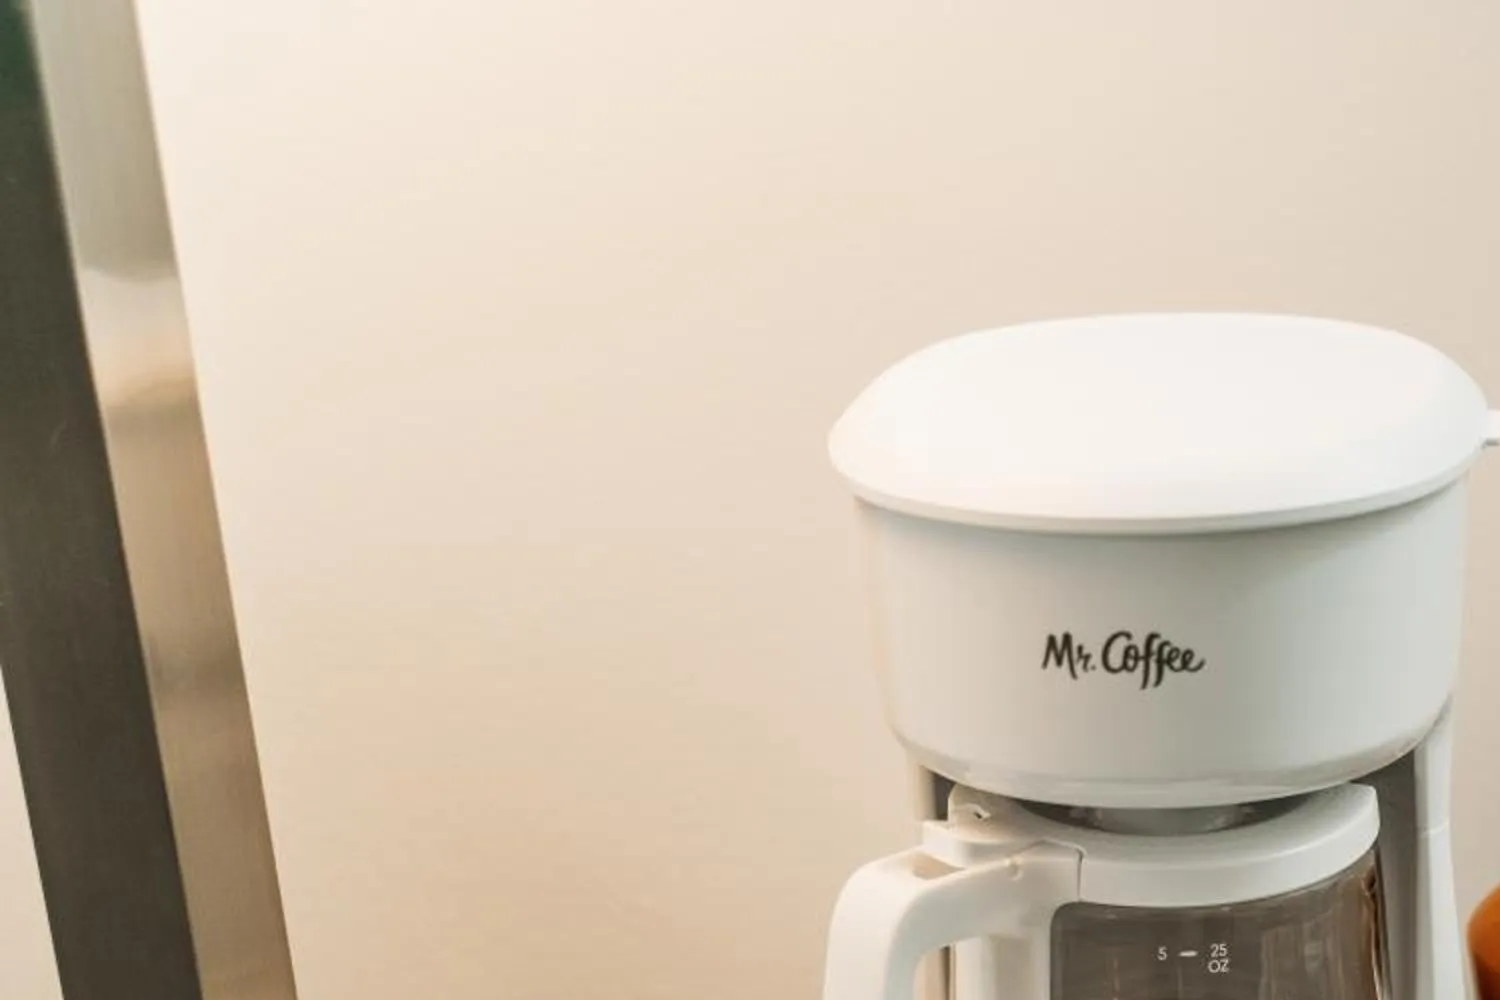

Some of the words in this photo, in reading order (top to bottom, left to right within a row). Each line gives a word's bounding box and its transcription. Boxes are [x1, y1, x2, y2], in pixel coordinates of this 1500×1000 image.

[1042, 631, 1096, 680] Mr.
[1101, 630, 1206, 690] Coffee
[1157, 945, 1168, 961] 5
[1209, 943, 1228, 958] 25
[1207, 959, 1229, 973] OZ
